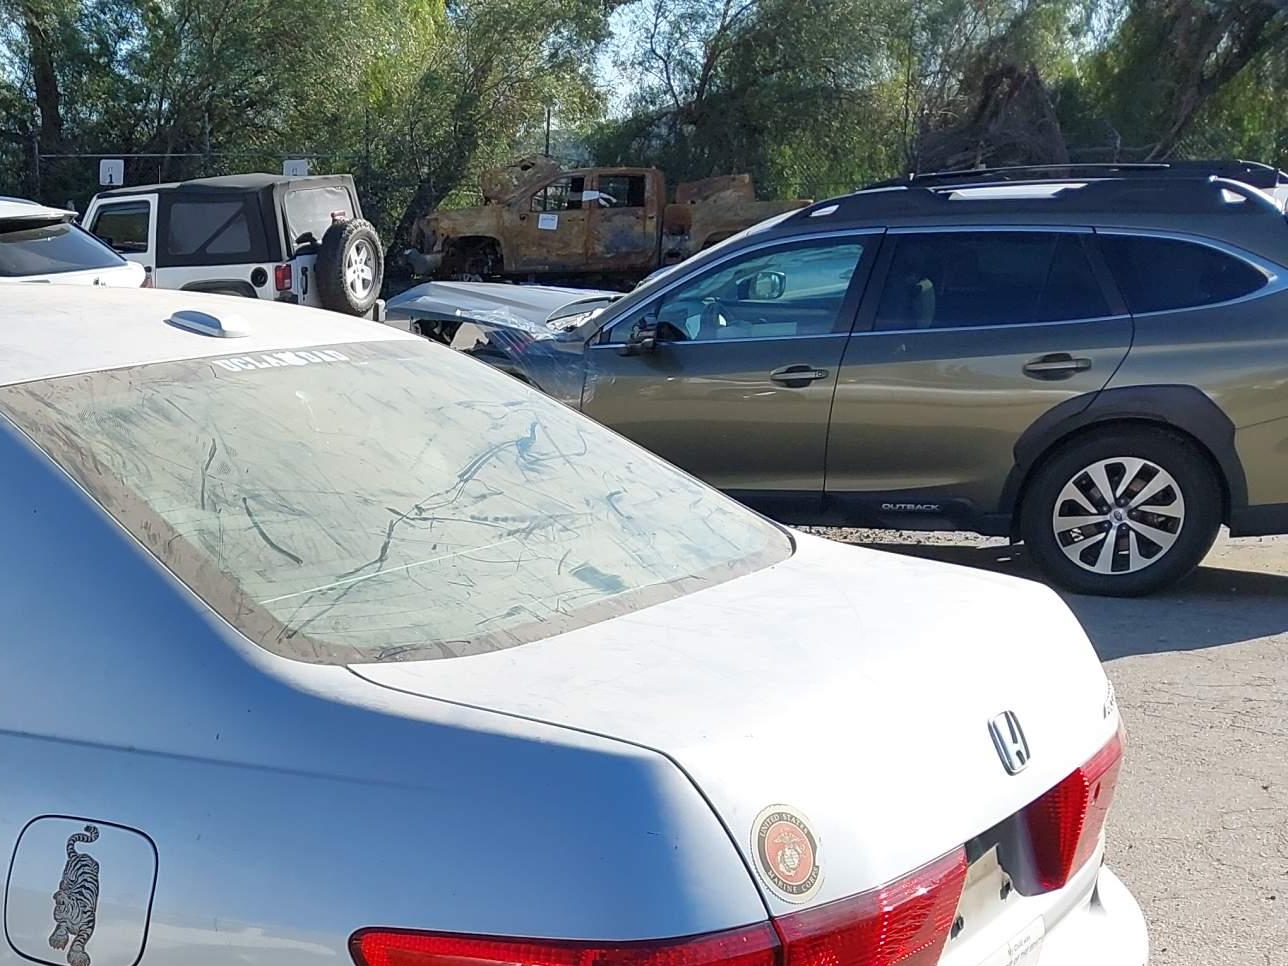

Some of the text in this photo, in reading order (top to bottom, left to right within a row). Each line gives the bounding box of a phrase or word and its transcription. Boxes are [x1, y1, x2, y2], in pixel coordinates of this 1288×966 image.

[212, 350, 349, 372] UCLA DAD
[881, 503, 941, 511] OUTBACK
[760, 813, 808, 838] UNITED STATES
[768, 866, 820, 894] MARINE CORPS
